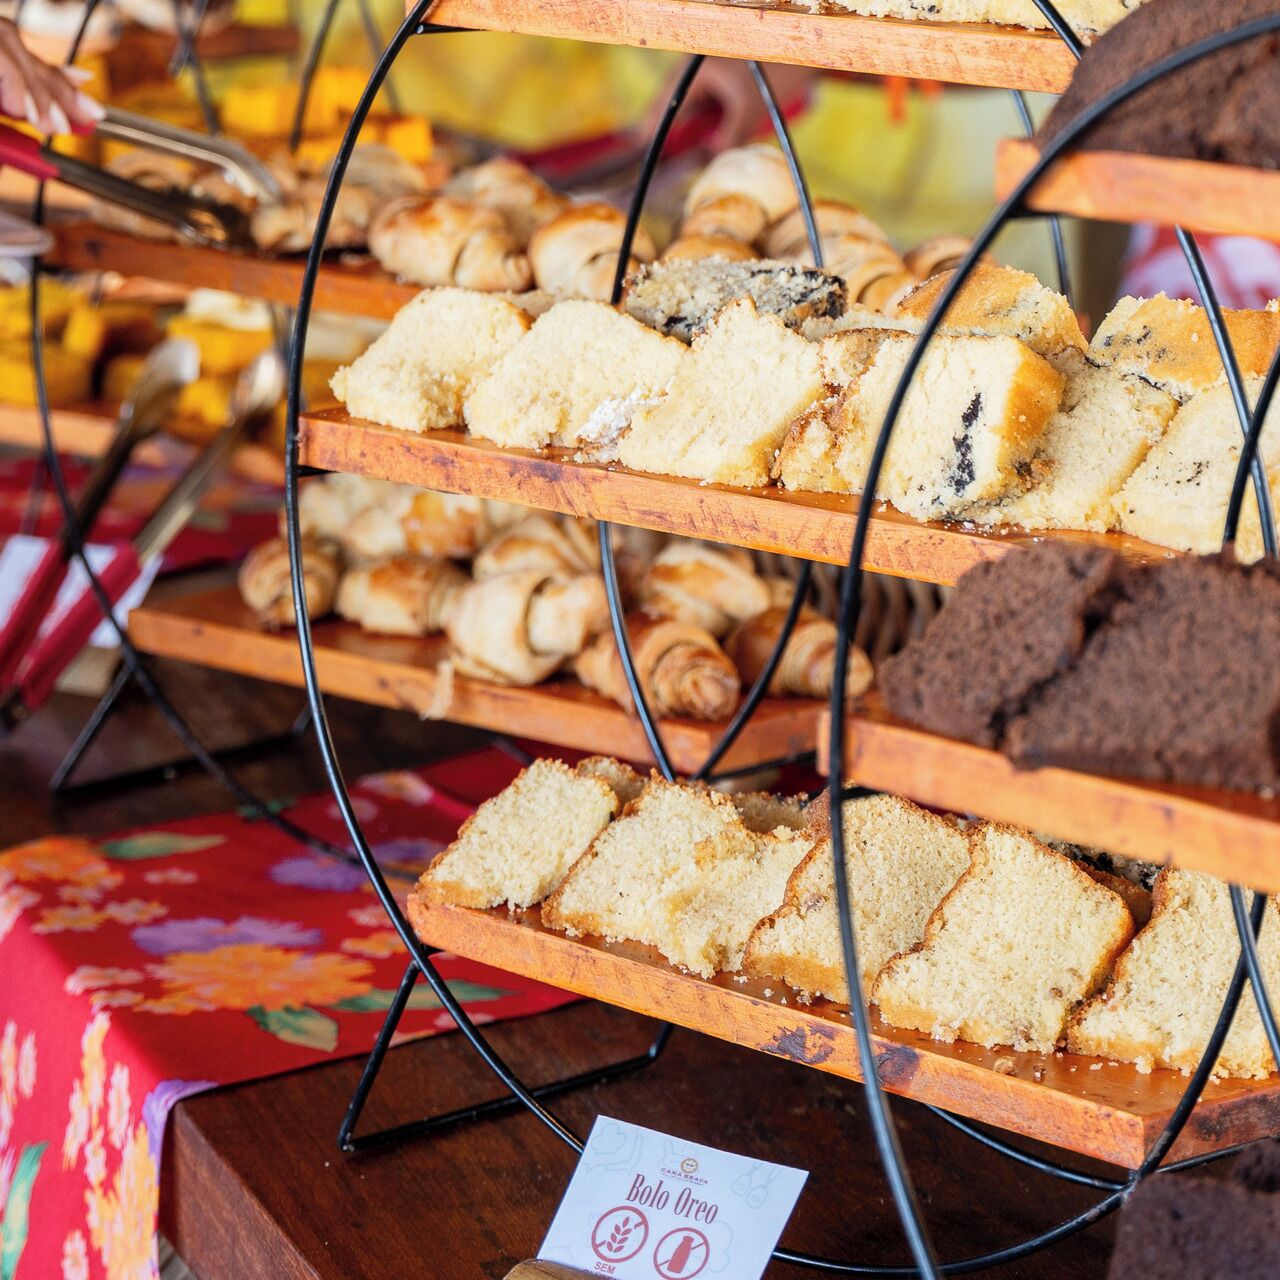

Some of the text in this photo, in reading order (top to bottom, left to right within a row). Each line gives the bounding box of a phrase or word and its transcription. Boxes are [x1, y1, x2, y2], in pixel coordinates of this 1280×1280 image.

[661, 1167, 682, 1178] CANA
[625, 1173, 718, 1224] Bolo Oreo
[594, 1261, 616, 1275] SEM
